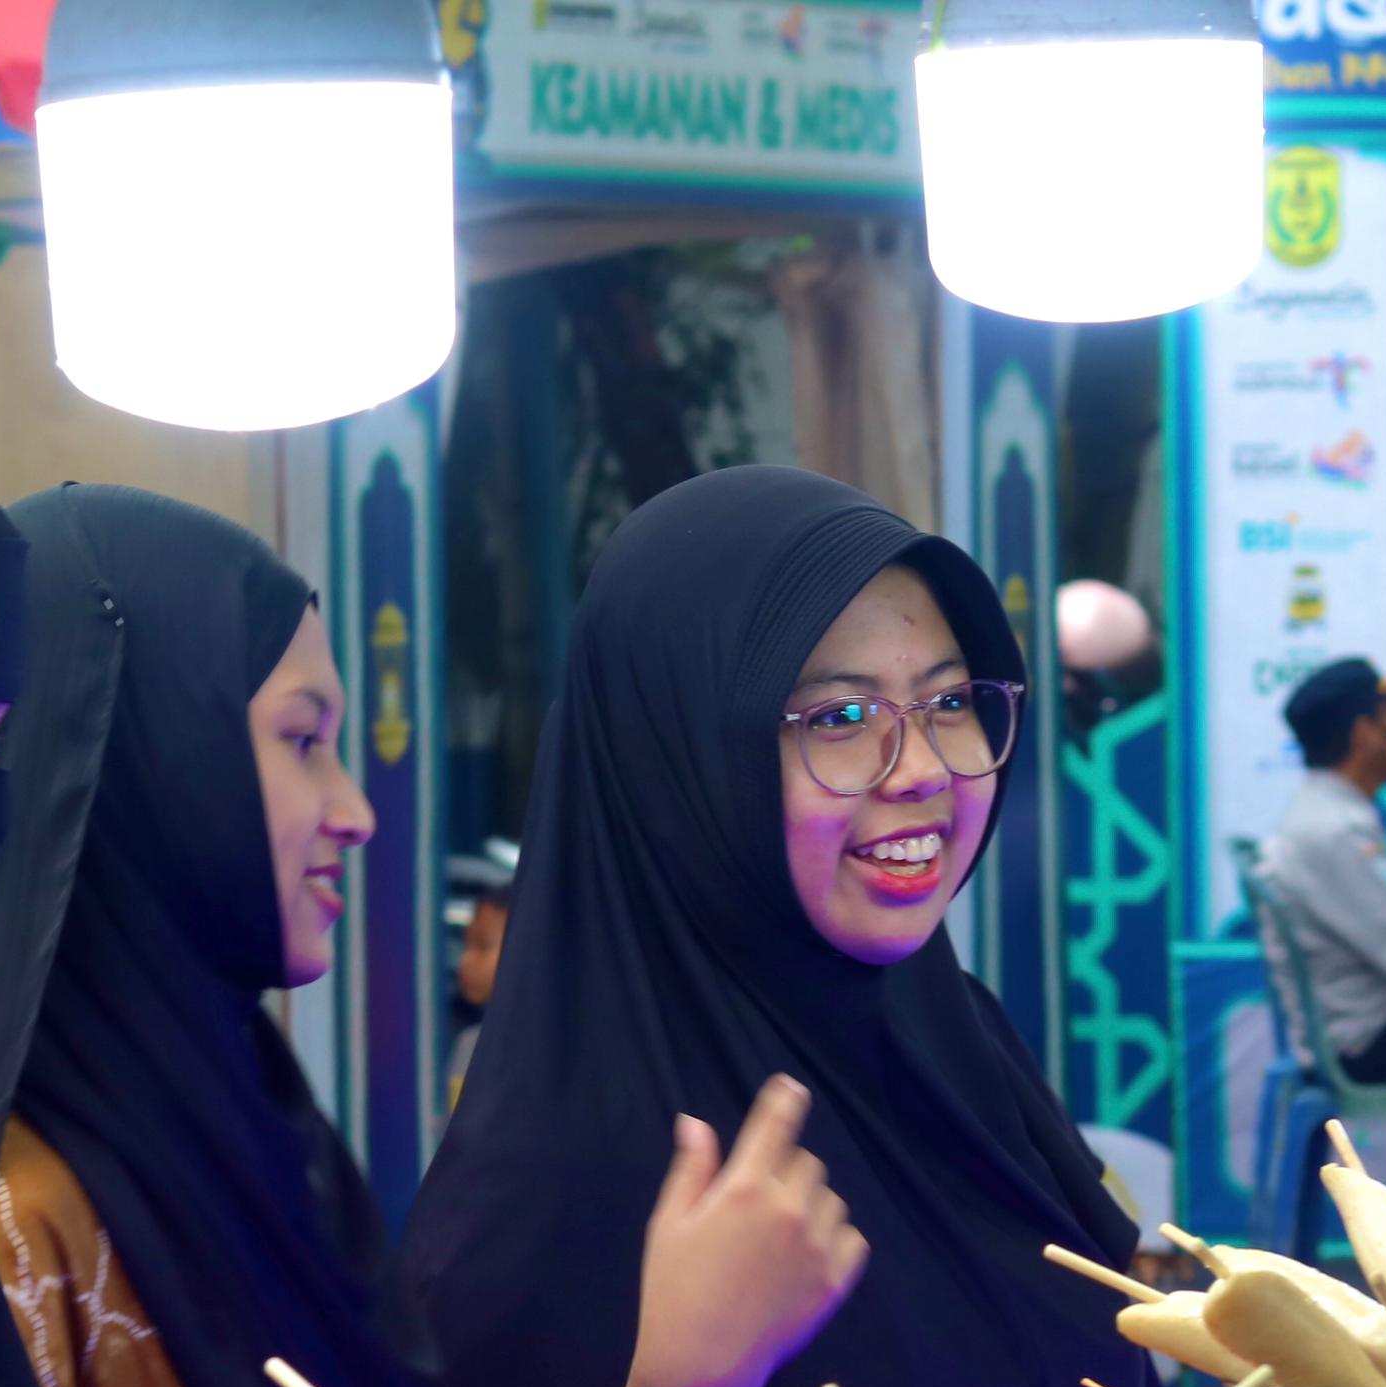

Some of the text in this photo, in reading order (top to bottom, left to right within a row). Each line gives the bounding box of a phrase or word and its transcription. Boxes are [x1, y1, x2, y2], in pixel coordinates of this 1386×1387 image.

[530, 61, 899, 156] KEAMANAN & MEDIS
